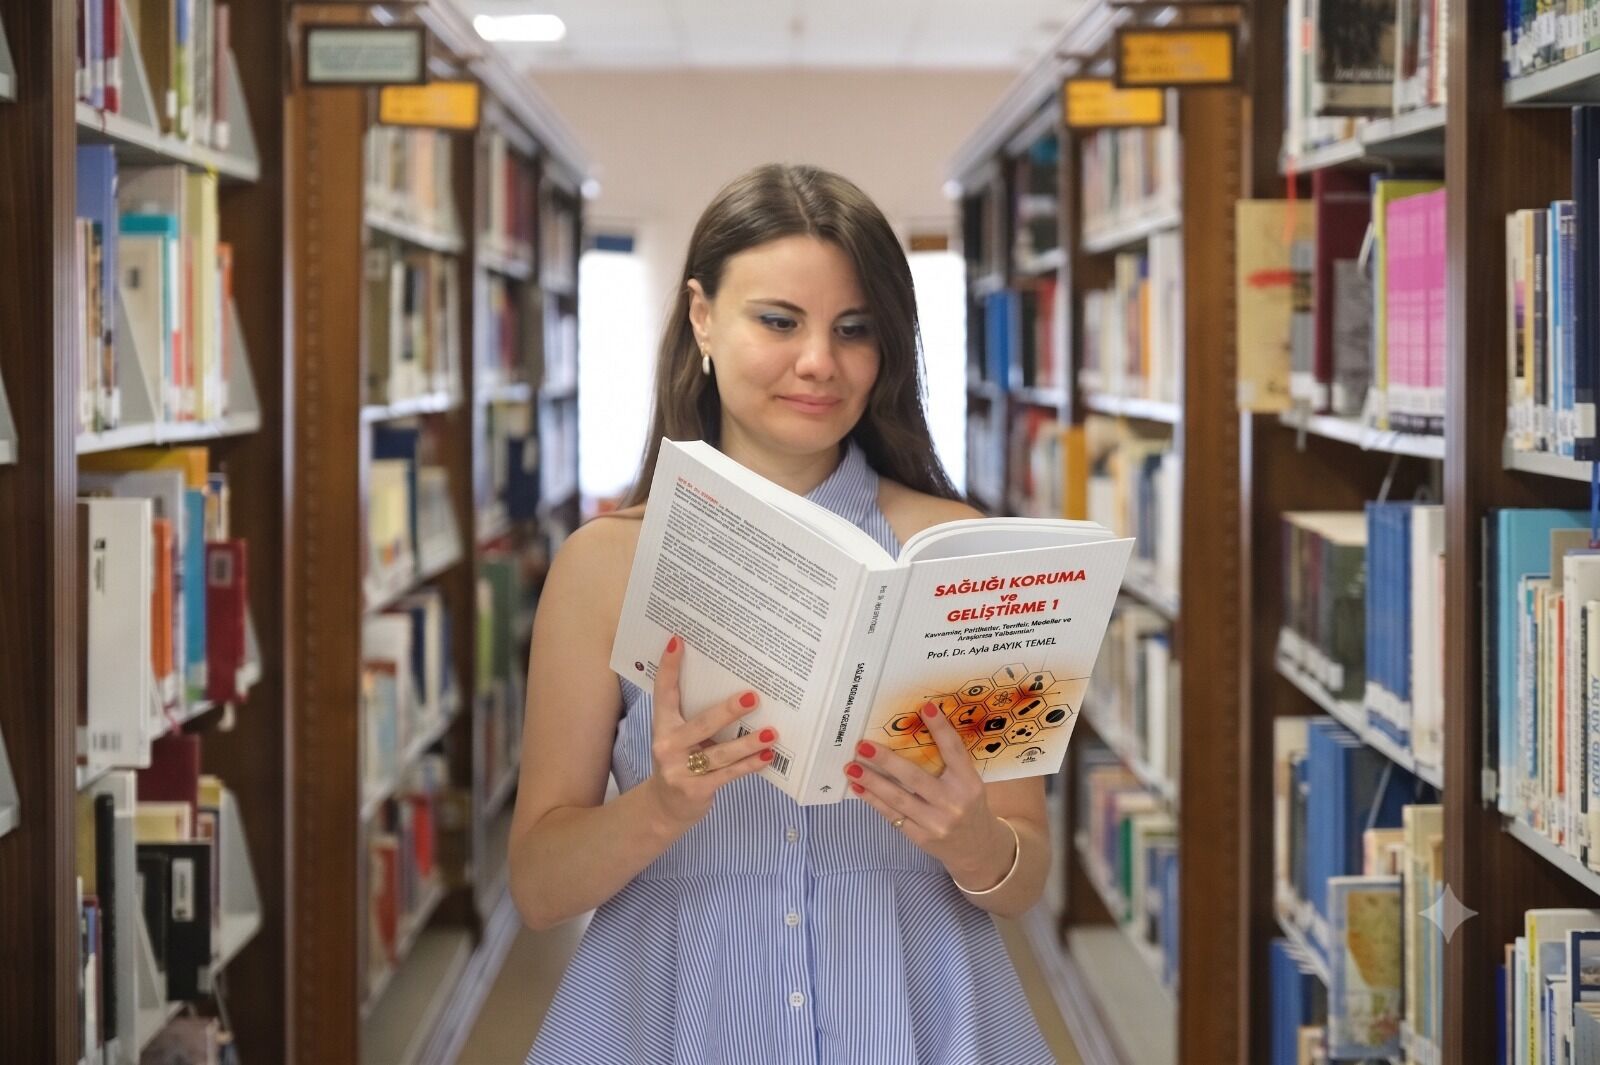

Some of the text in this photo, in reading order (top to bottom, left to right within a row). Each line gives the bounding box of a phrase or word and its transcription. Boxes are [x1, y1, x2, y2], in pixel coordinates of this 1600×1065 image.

[934, 569, 1086, 597] SAĞLIĞI KORUMA
[1000, 593, 1018, 602] ve
[947, 599, 1060, 622] GELİŞTİRME 1
[926, 637, 1057, 660] Prof. Dr. Ayla BAYIK TEMEL
